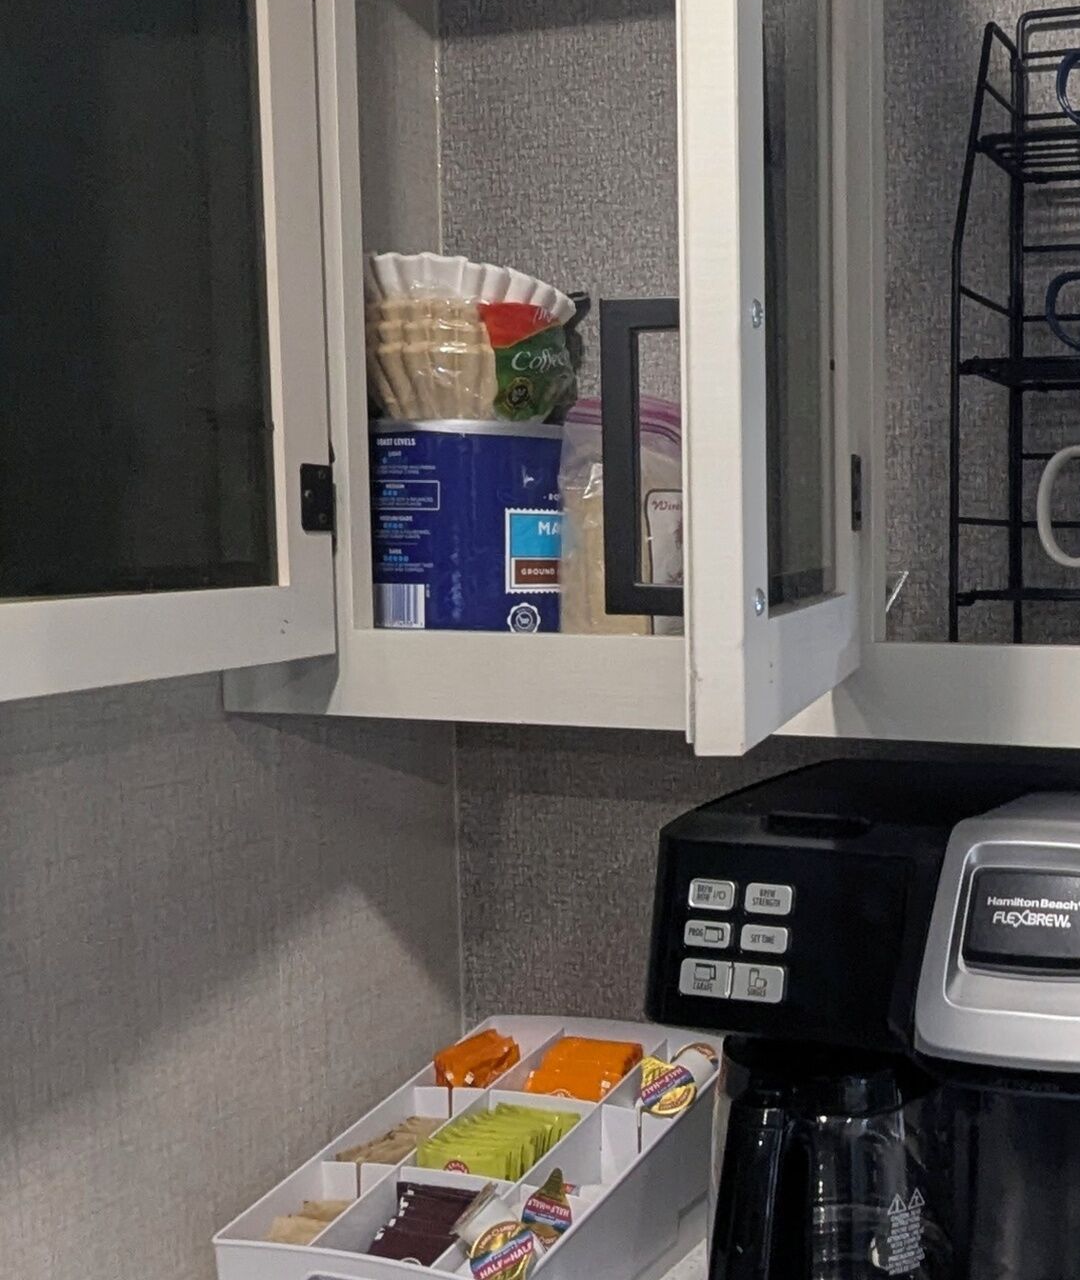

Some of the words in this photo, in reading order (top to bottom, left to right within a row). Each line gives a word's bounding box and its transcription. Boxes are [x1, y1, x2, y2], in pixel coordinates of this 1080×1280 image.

[520, 568, 555, 576] GROUND
[752, 897, 781, 907] STRENGTH
[986, 896, 1039, 908] Hamilton
[479, 1259, 504, 1279] HALF
[510, 1241, 533, 1261] HALF
